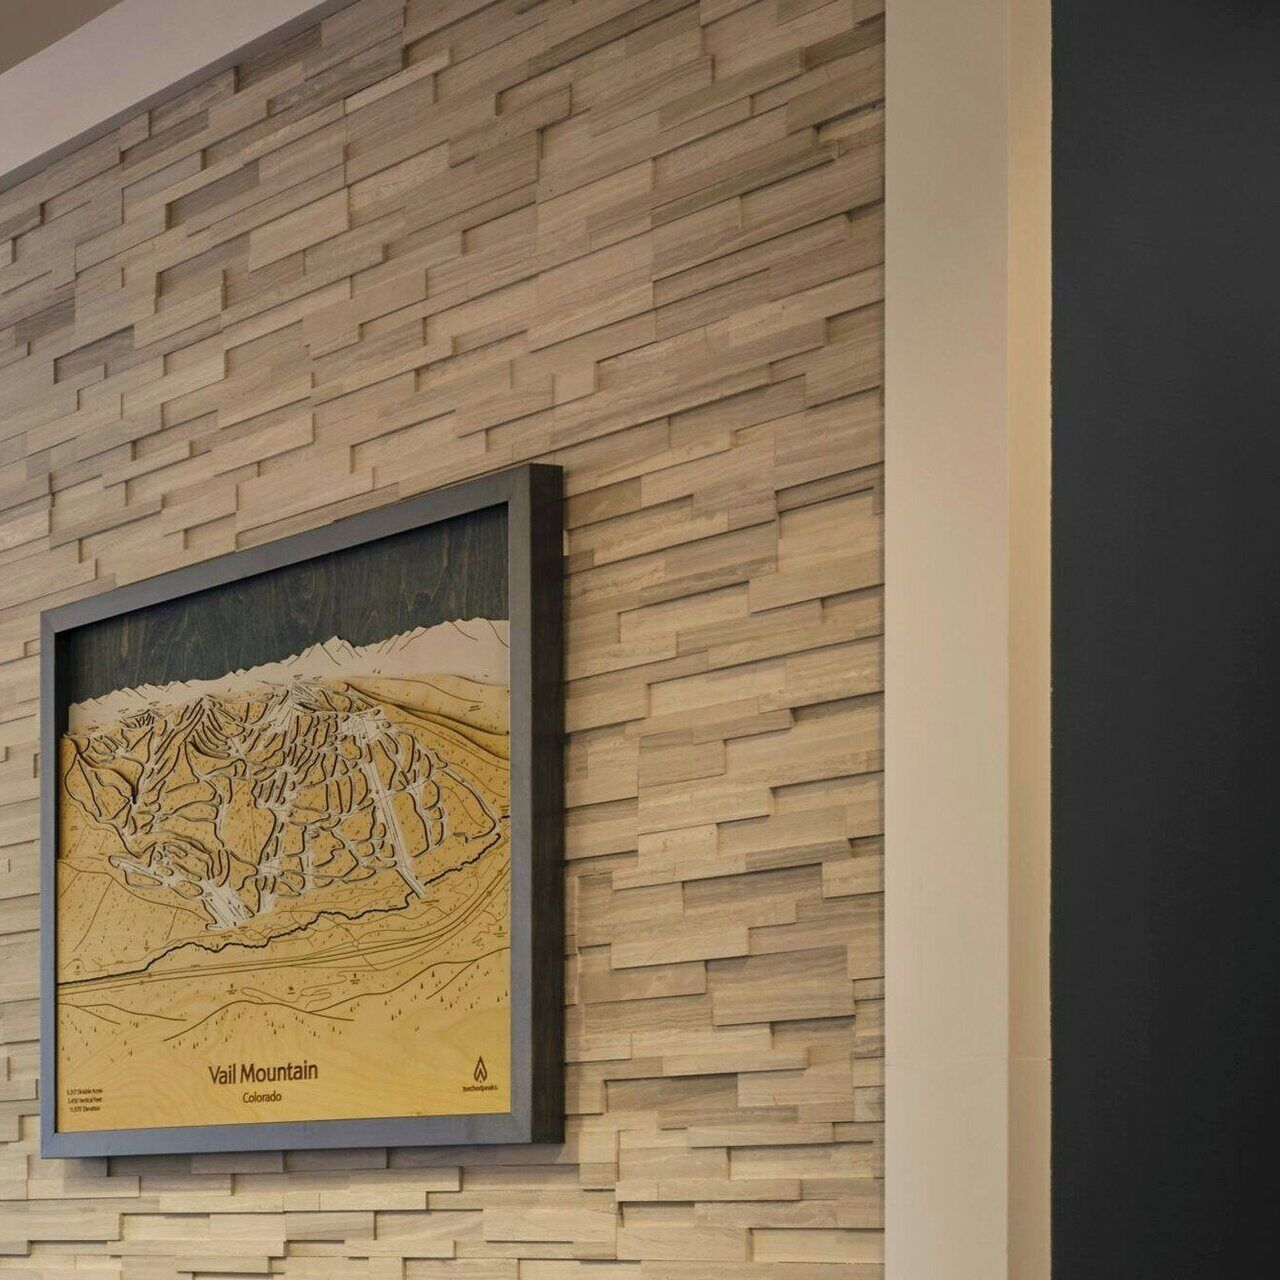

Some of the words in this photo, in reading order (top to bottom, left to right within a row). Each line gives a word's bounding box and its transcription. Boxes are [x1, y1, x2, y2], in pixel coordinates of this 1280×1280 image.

[208, 1063, 237, 1085] Vail
[240, 1060, 319, 1083] Mountain
[242, 1090, 282, 1104] Colorado
